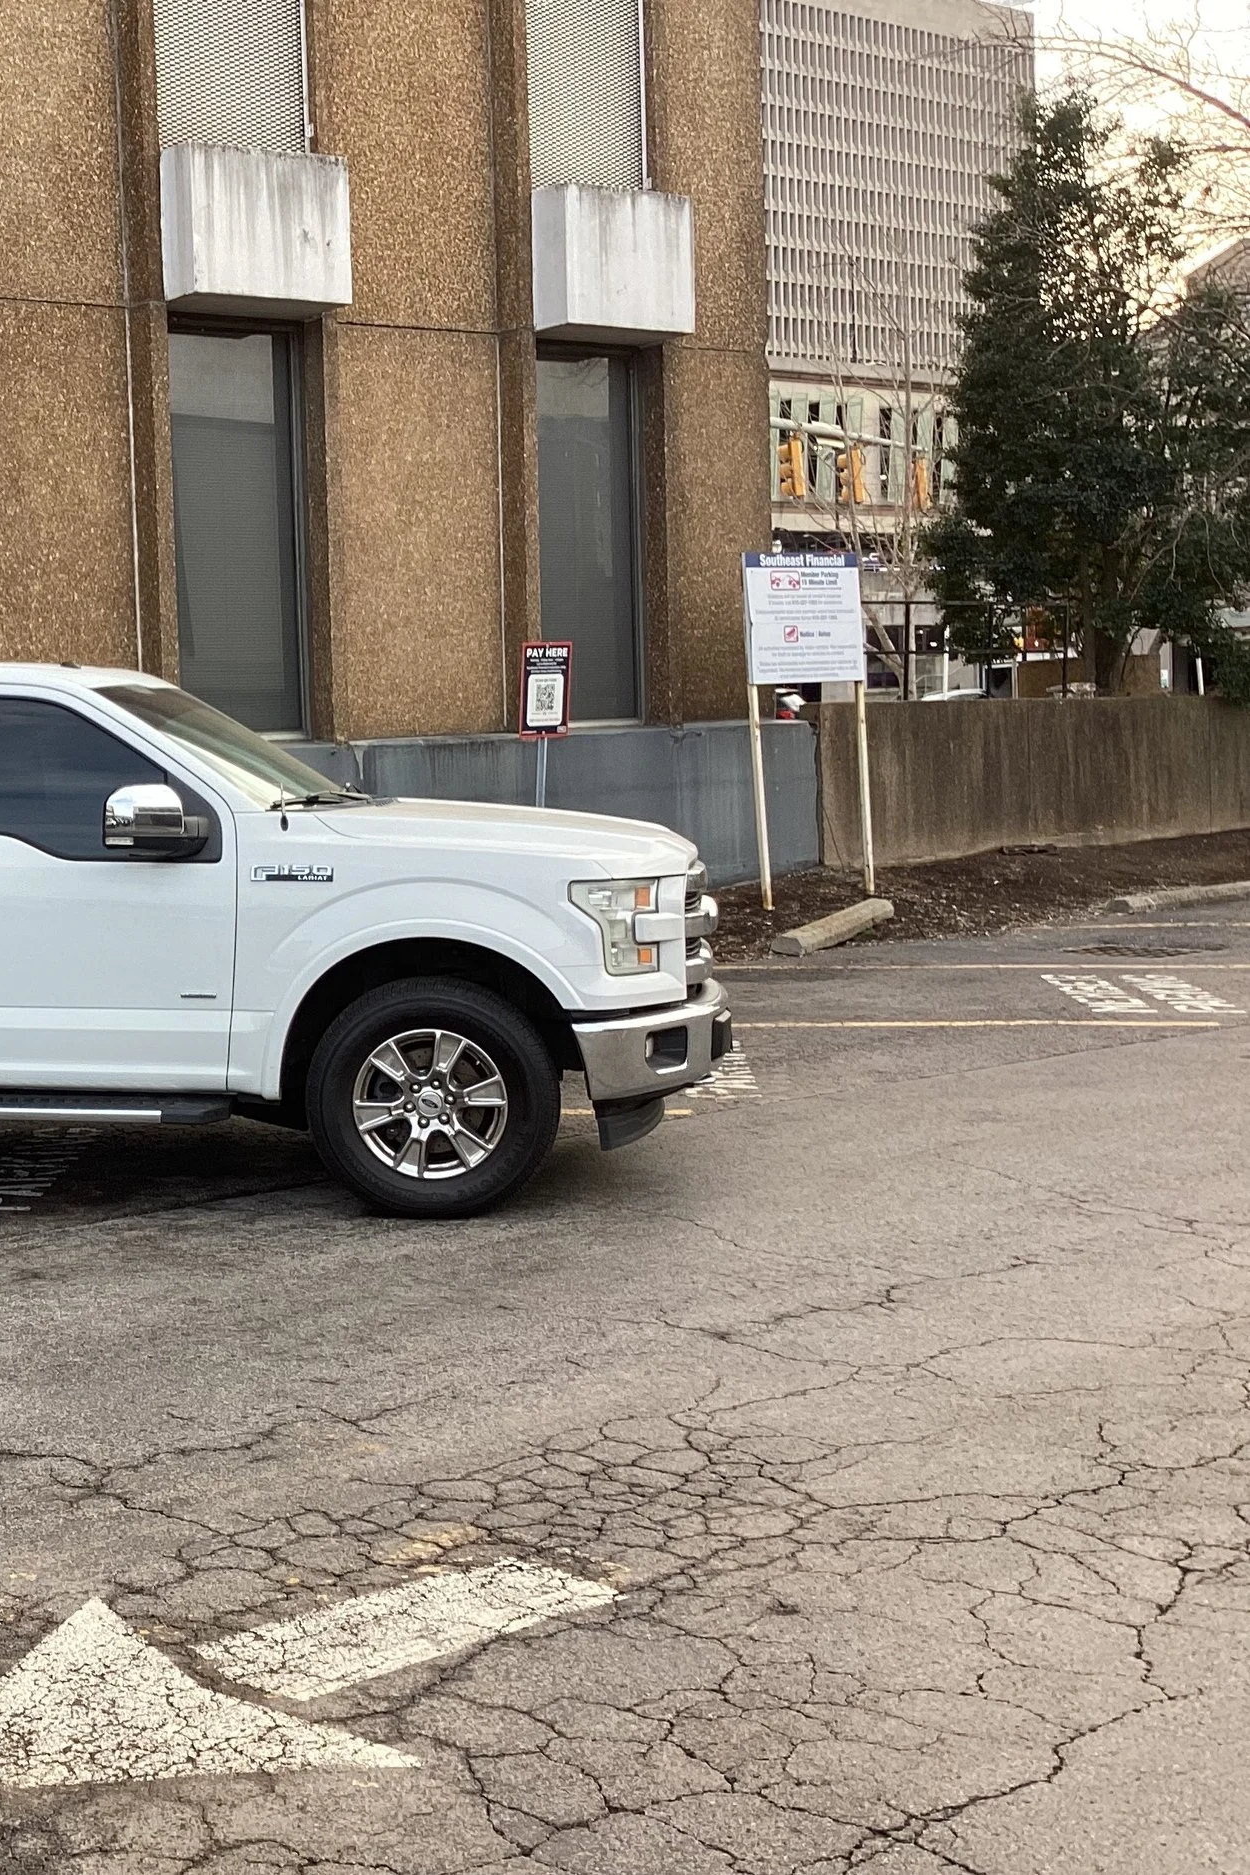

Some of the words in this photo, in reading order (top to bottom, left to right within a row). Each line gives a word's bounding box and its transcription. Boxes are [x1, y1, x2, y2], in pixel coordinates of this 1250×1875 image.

[759, 553, 804, 567] Southeast
[805, 553, 845, 567] Financial
[820, 571, 839, 579] Parking
[526, 647, 544, 658] PAY
[545, 647, 568, 657] HERE
